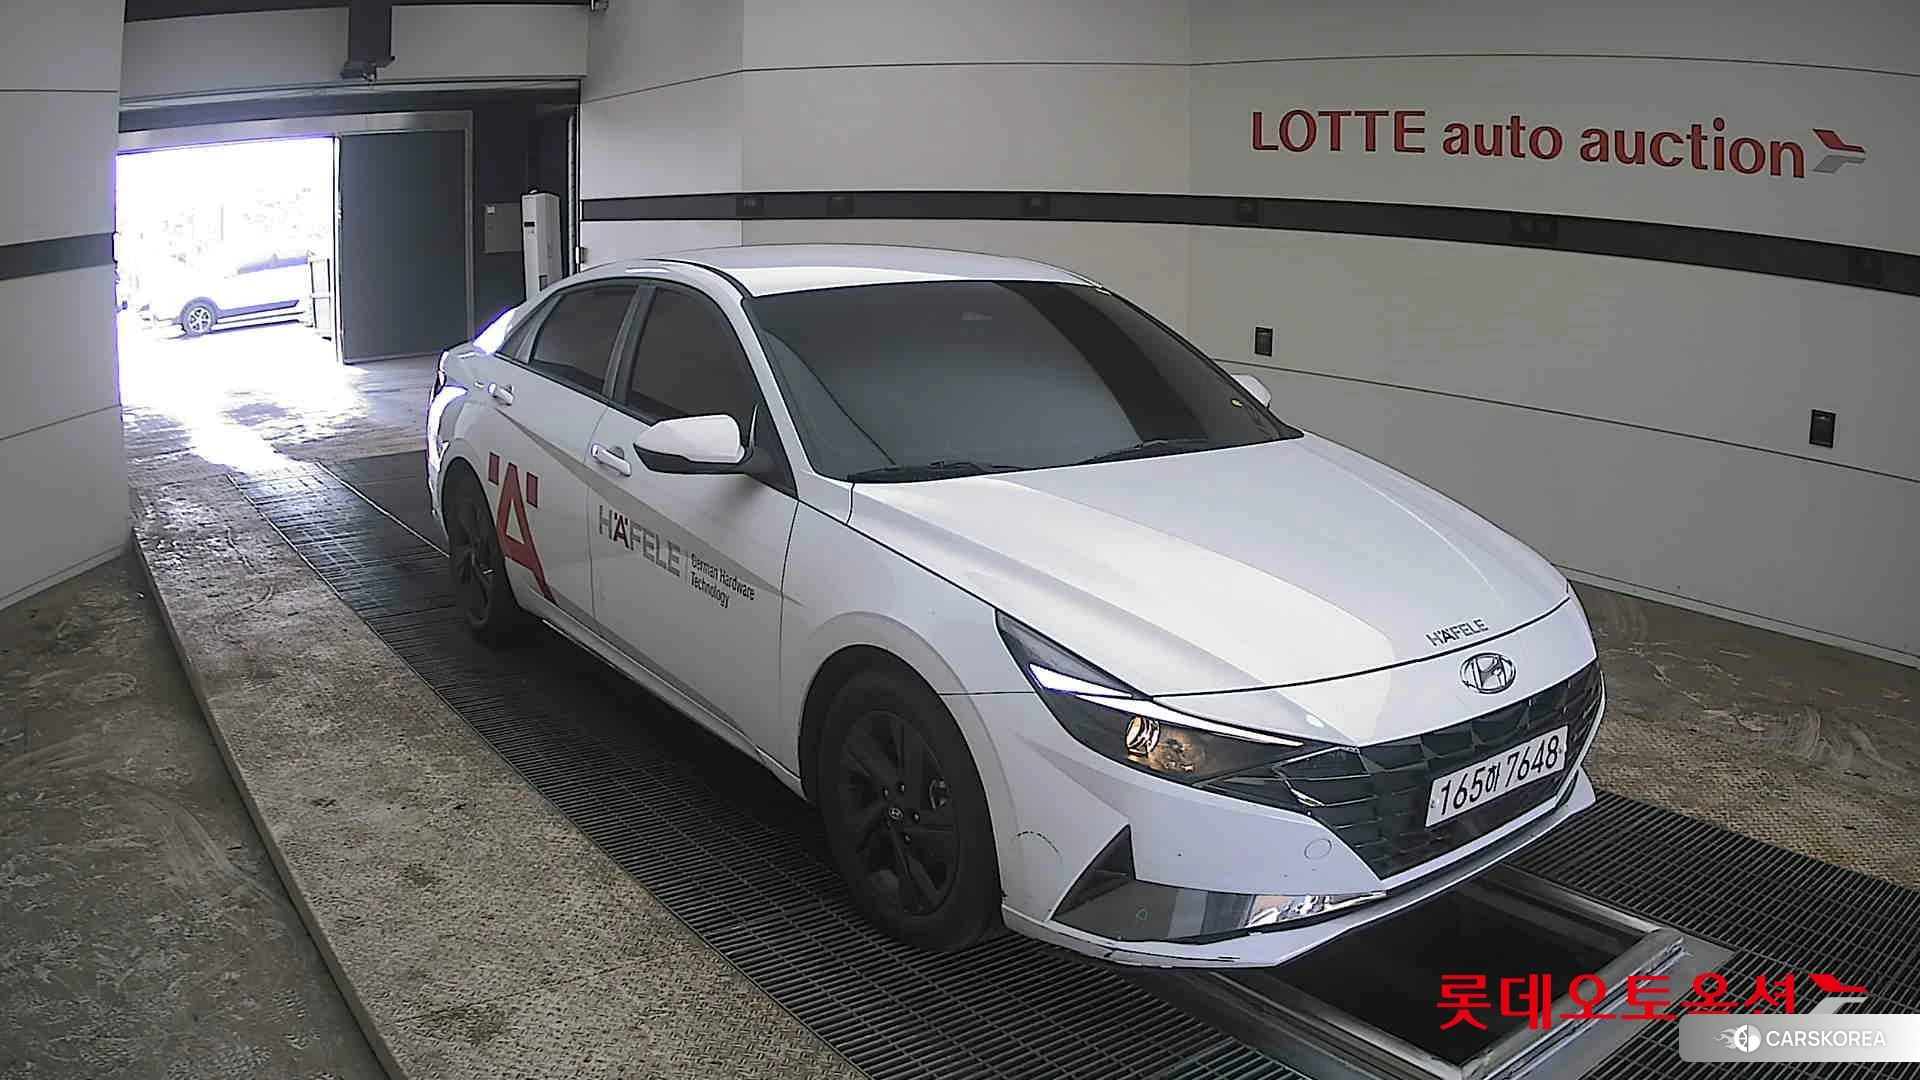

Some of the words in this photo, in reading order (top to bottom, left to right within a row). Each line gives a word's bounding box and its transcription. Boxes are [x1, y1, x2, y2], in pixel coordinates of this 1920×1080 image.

[1252, 110, 1426, 154] LOTTE
[1441, 115, 1563, 161] auto
[1579, 117, 1805, 179] auction
[690, 571, 730, 609] Technology
[691, 553, 719, 581] German
[719, 568, 755, 601] Hardware
[1504, 735, 1560, 788] 7648
